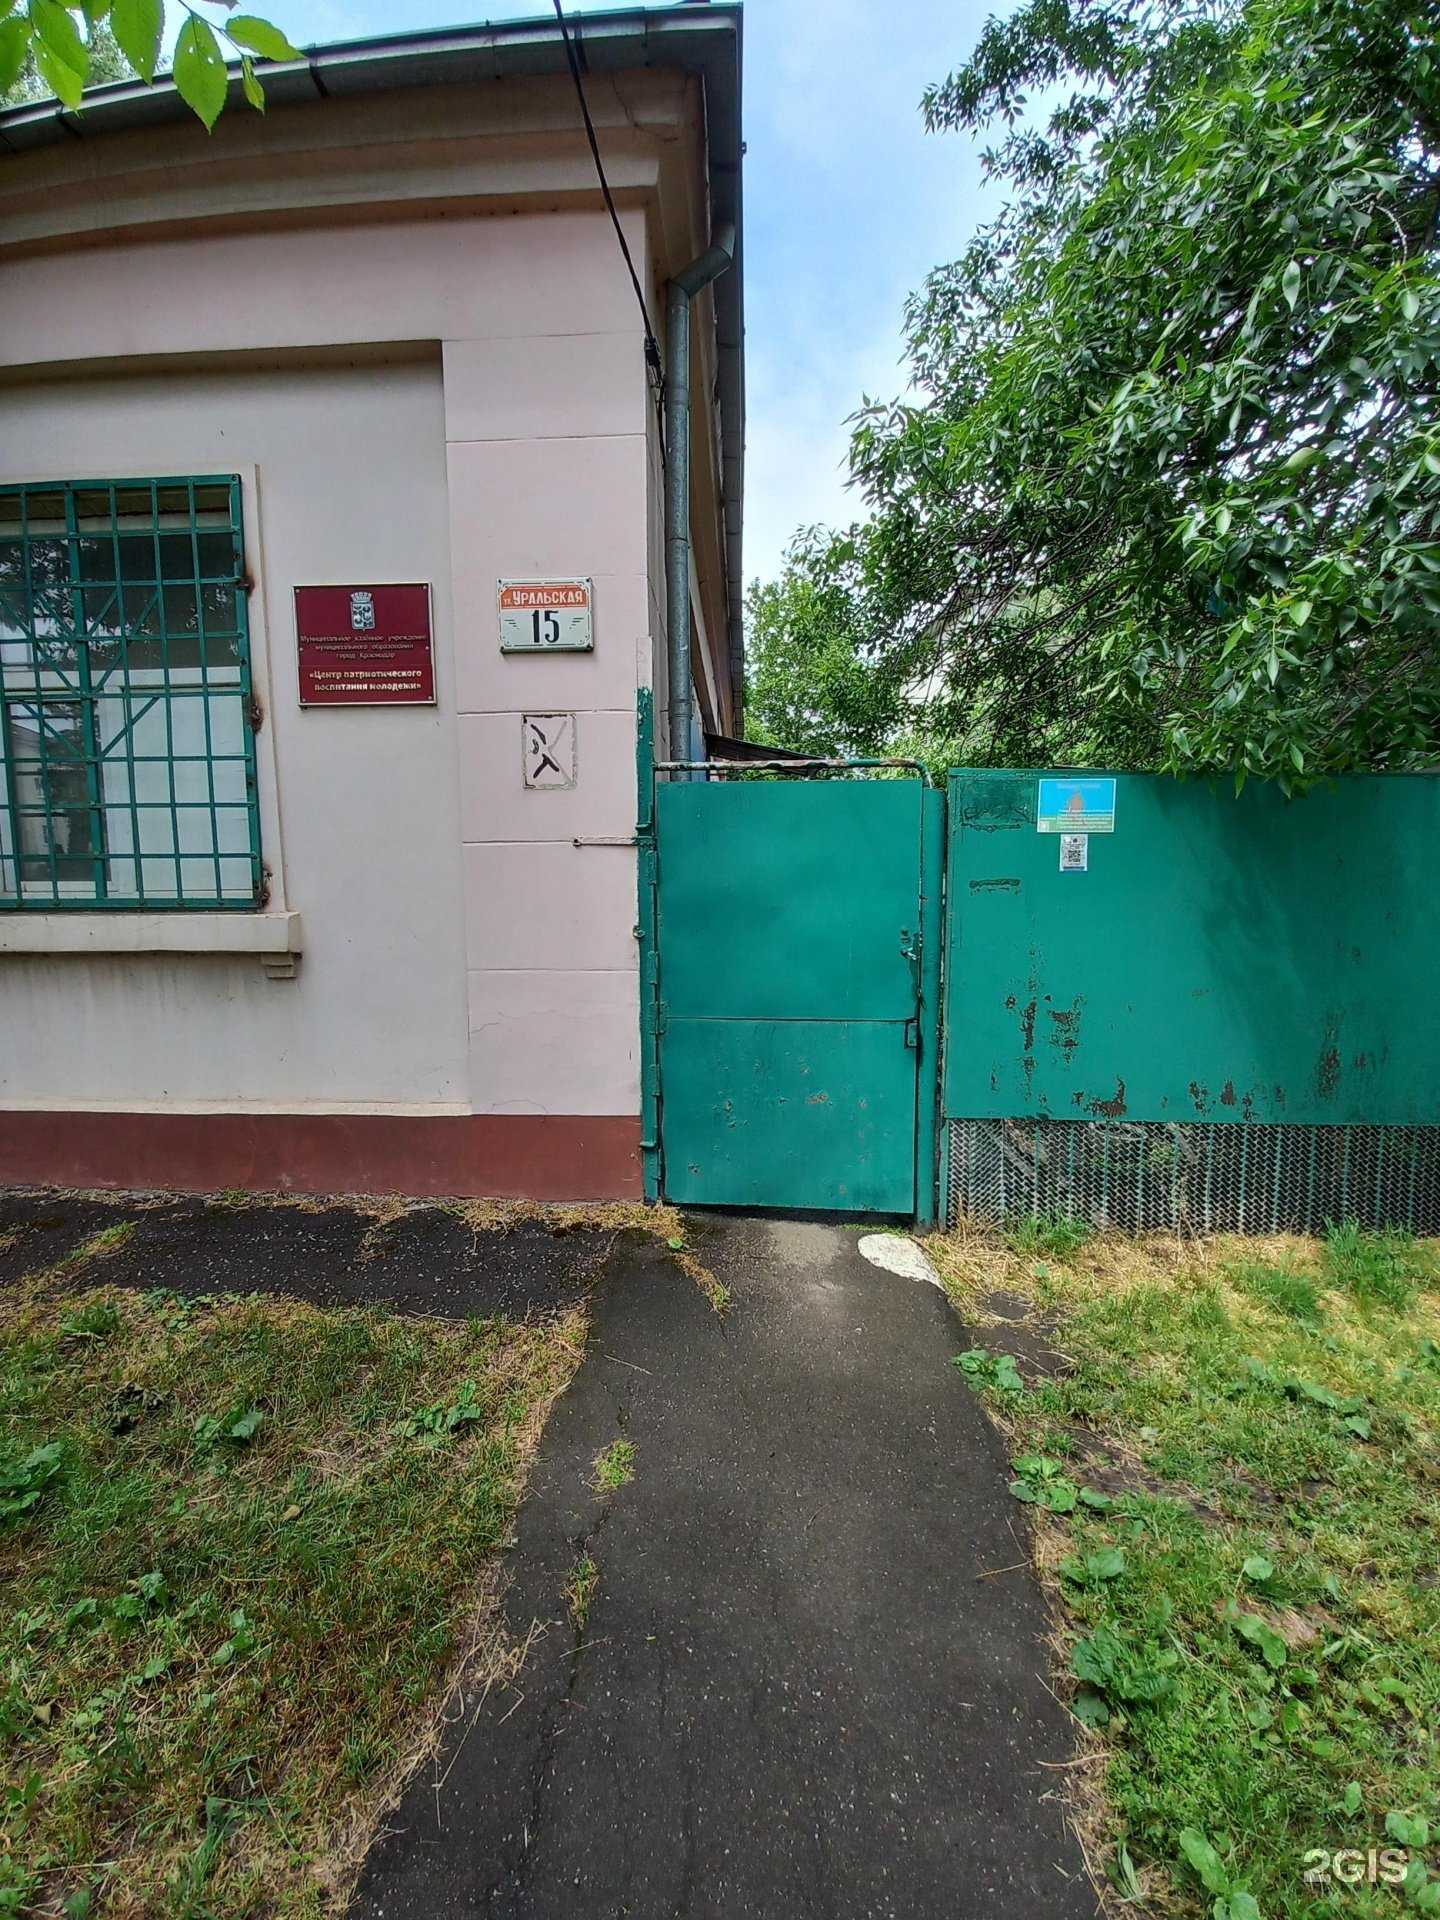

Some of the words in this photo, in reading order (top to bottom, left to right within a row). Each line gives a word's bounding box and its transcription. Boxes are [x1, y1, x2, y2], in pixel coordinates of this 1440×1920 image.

[512, 590, 583, 605] УРАЛЬСКАЯ
[531, 609, 560, 643] 15
[309, 669, 342, 680] «Центр
[343, 669, 422, 679] патриотического
[314, 683, 368, 691] воспитания
